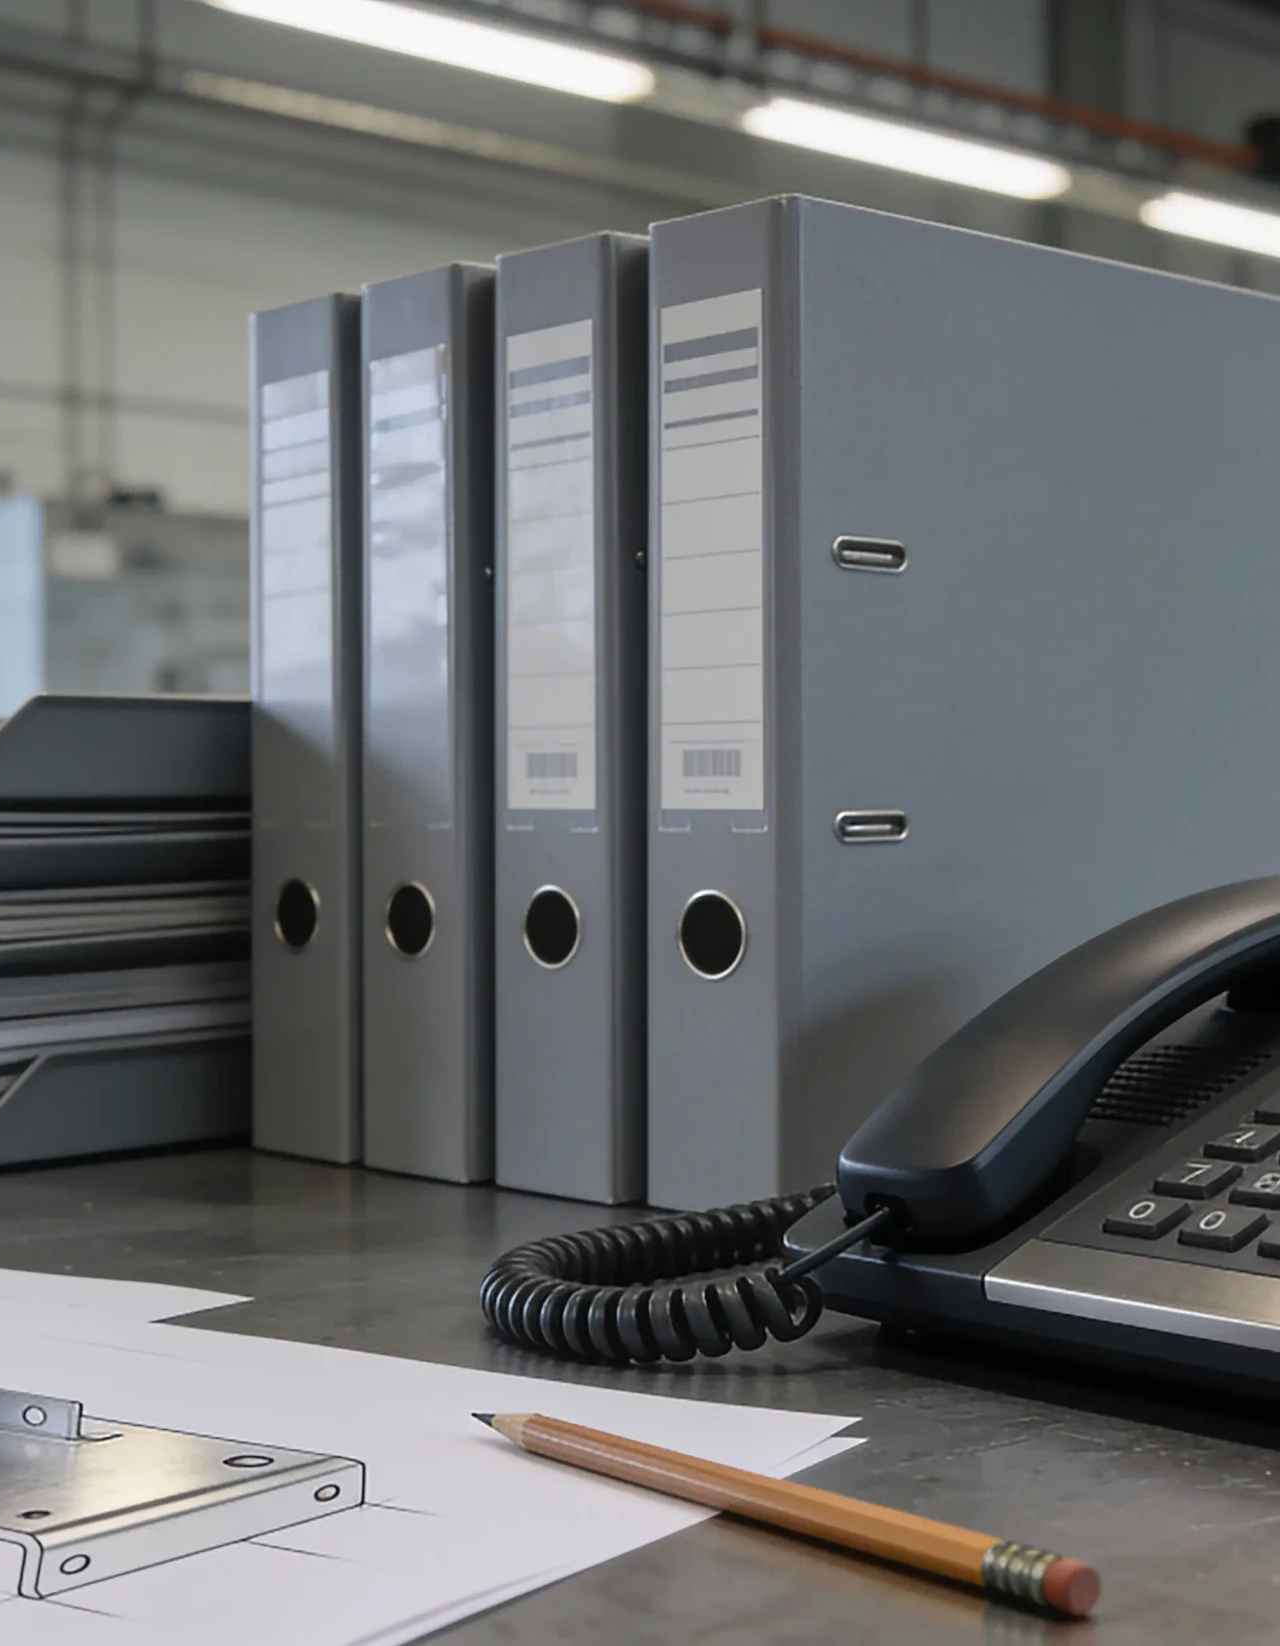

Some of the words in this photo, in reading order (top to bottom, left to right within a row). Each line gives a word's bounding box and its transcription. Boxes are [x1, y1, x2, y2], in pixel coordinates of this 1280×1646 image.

[1181, 1163, 1212, 1183] 7
[1129, 1200, 1156, 1219] 0
[1198, 1210, 1227, 1230] 0
